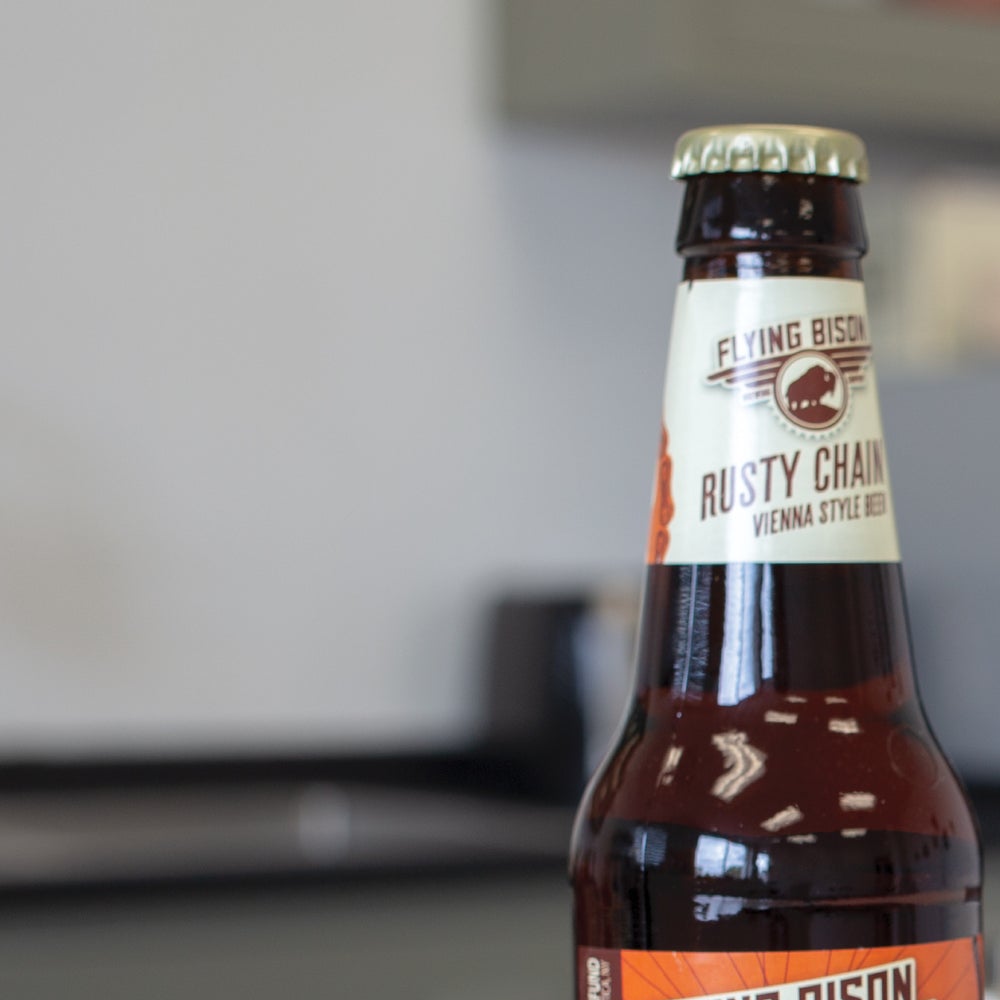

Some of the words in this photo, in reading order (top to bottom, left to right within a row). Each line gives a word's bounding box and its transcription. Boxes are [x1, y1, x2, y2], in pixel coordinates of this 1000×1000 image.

[718, 321, 802, 367] FLYING
[812, 314, 867, 346] BISON
[701, 450, 801, 521] RUSTY
[753, 504, 814, 538] VIENNA
[819, 494, 861, 524] STYLE
